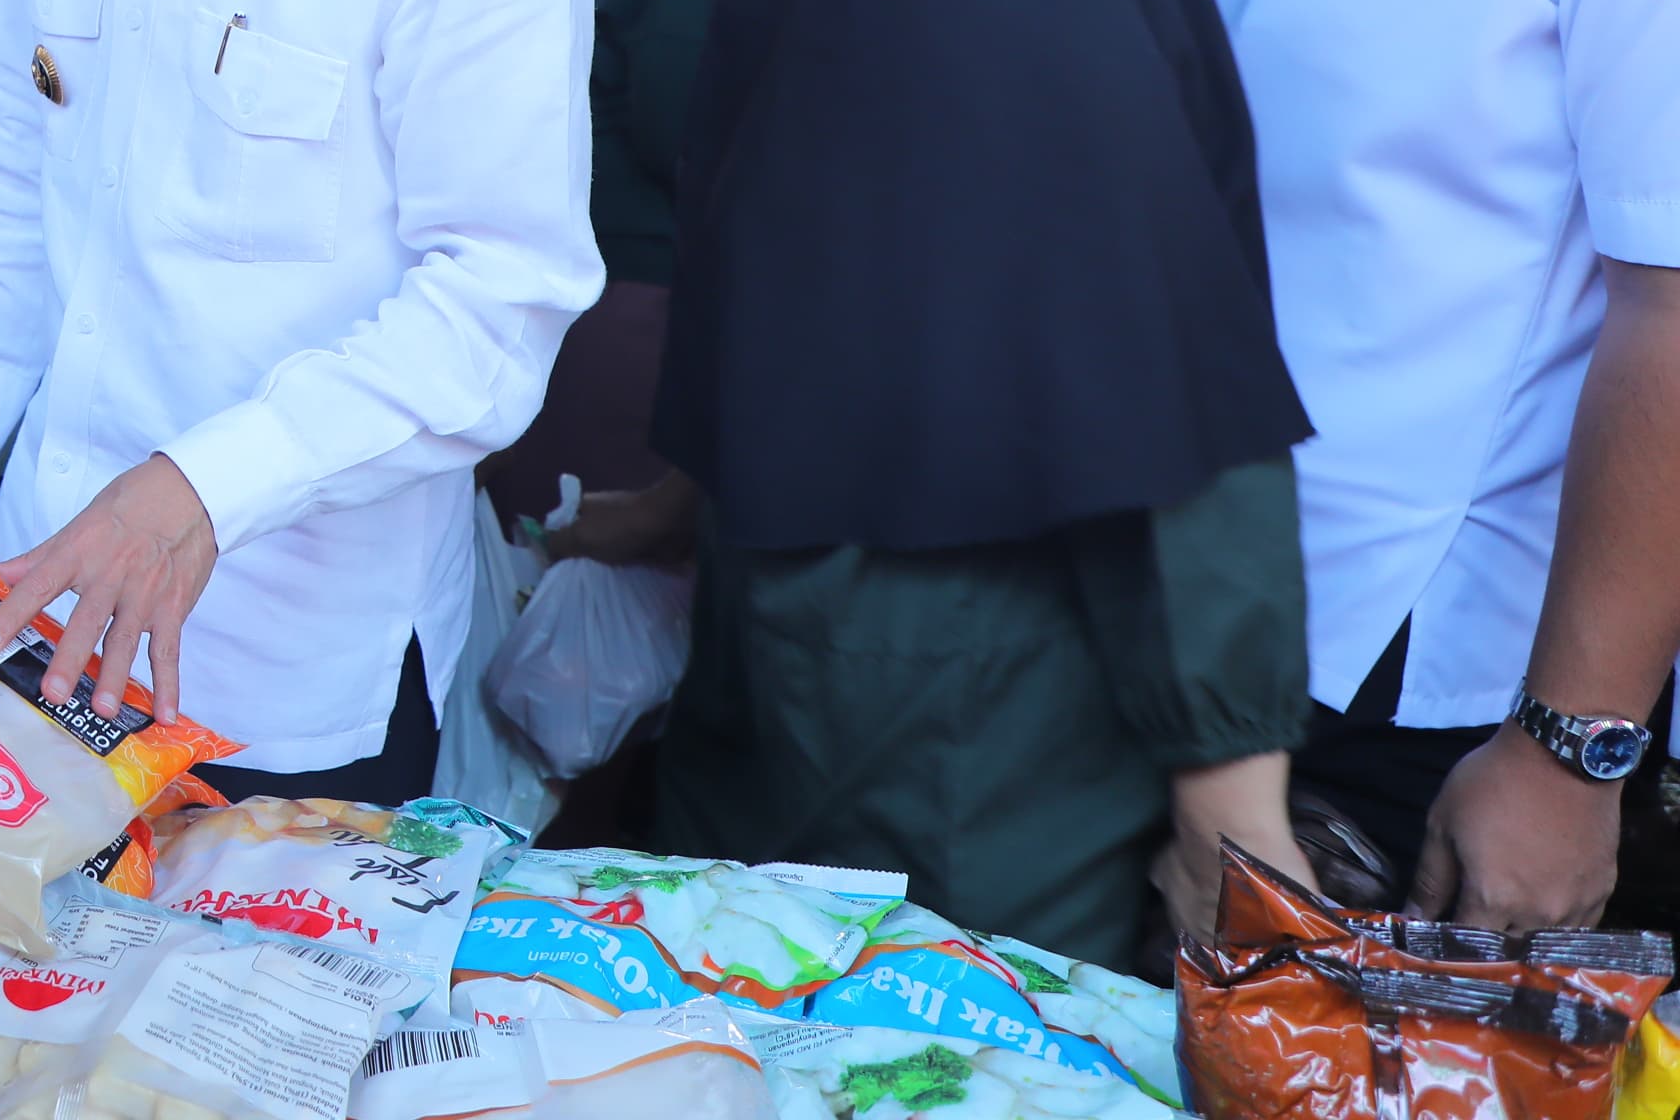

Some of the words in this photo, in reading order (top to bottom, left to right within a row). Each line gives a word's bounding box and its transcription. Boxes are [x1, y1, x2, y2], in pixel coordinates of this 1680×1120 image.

[81, 707, 121, 739] Fish
[463, 916, 537, 938] Ika
[527, 950, 588, 964] Olahan
